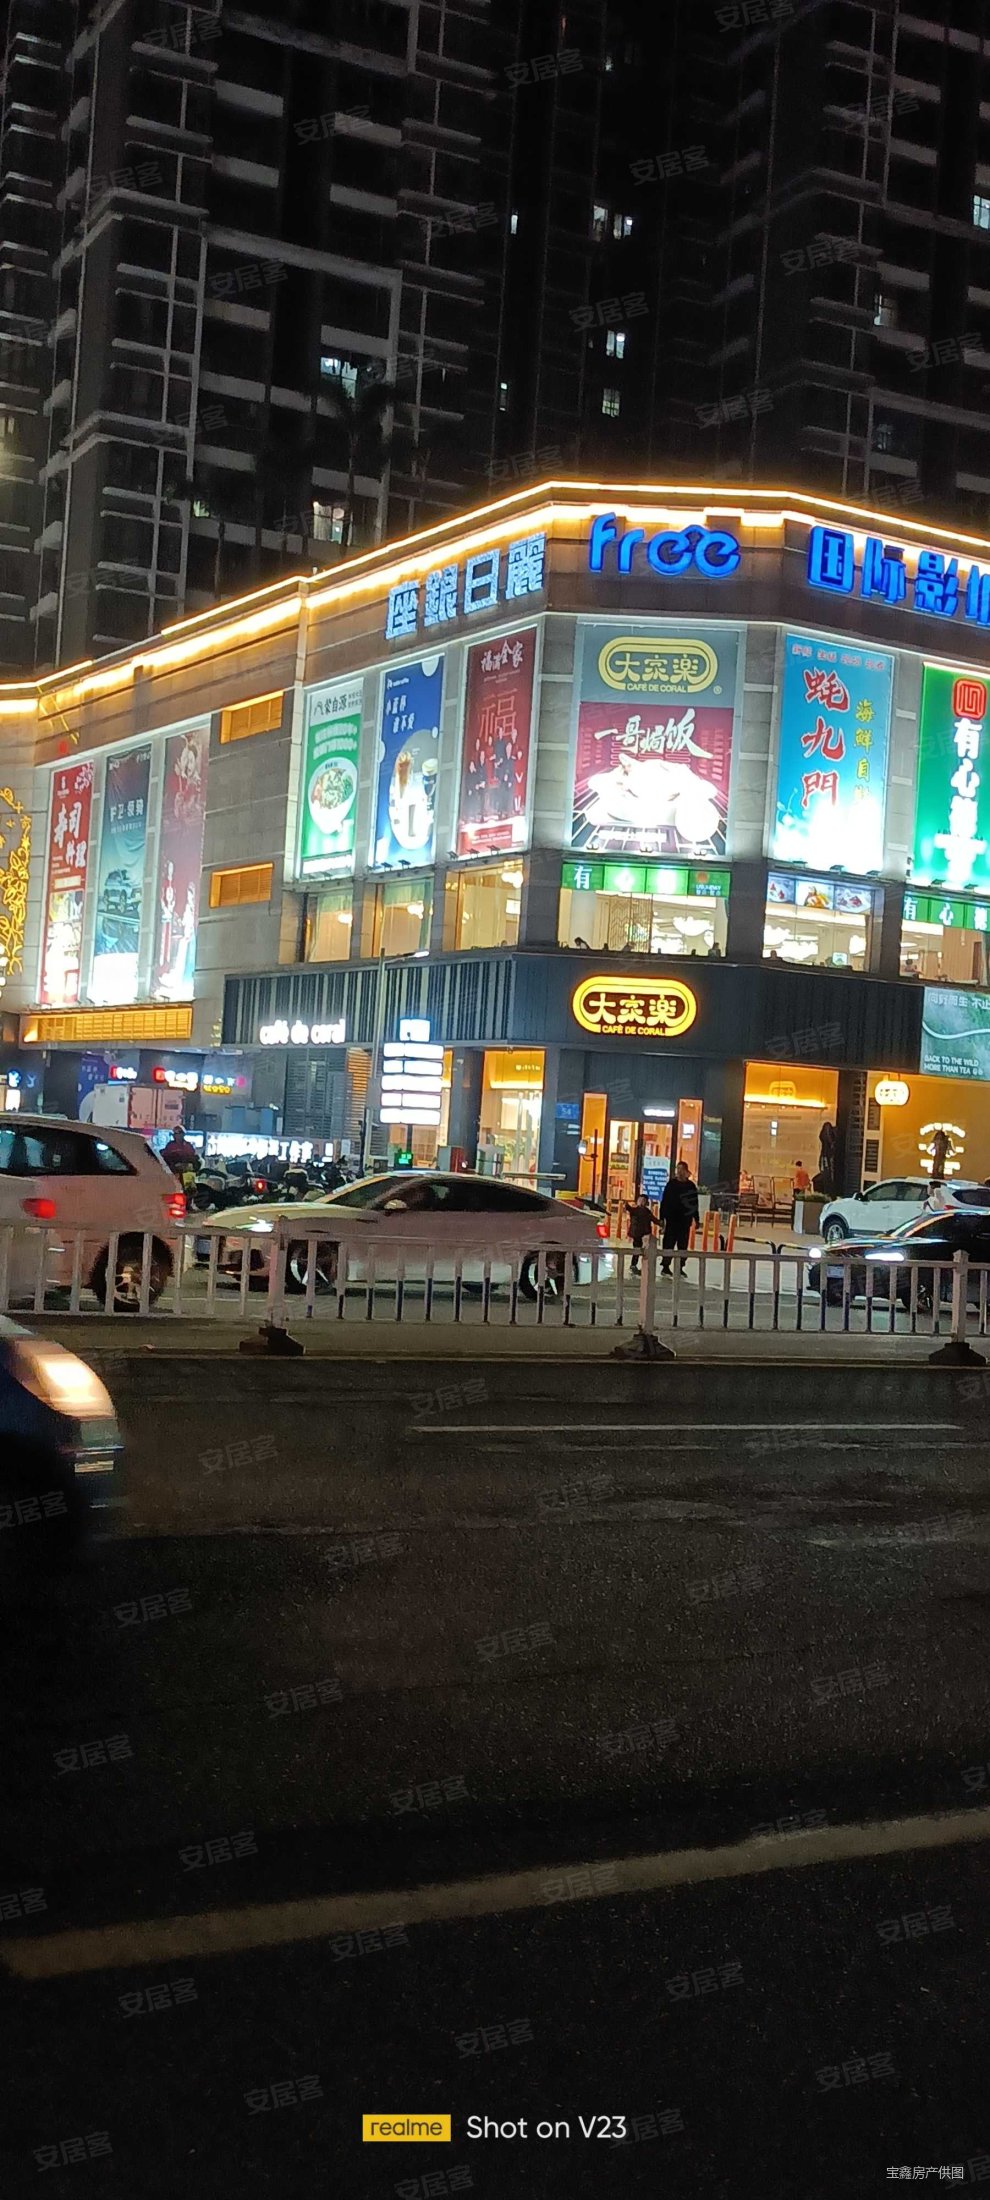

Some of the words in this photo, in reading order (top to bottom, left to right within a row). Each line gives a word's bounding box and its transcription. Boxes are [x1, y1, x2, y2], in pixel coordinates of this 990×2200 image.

[588, 511, 742, 578] free
[648, 684, 660, 692] DE
[660, 684, 687, 693] CORAL
[624, 1026, 637, 1035] DE
[637, 1027, 666, 1036] CORAL
[941, 1055, 950, 1064] TO
[951, 1057, 963, 1065] THE
